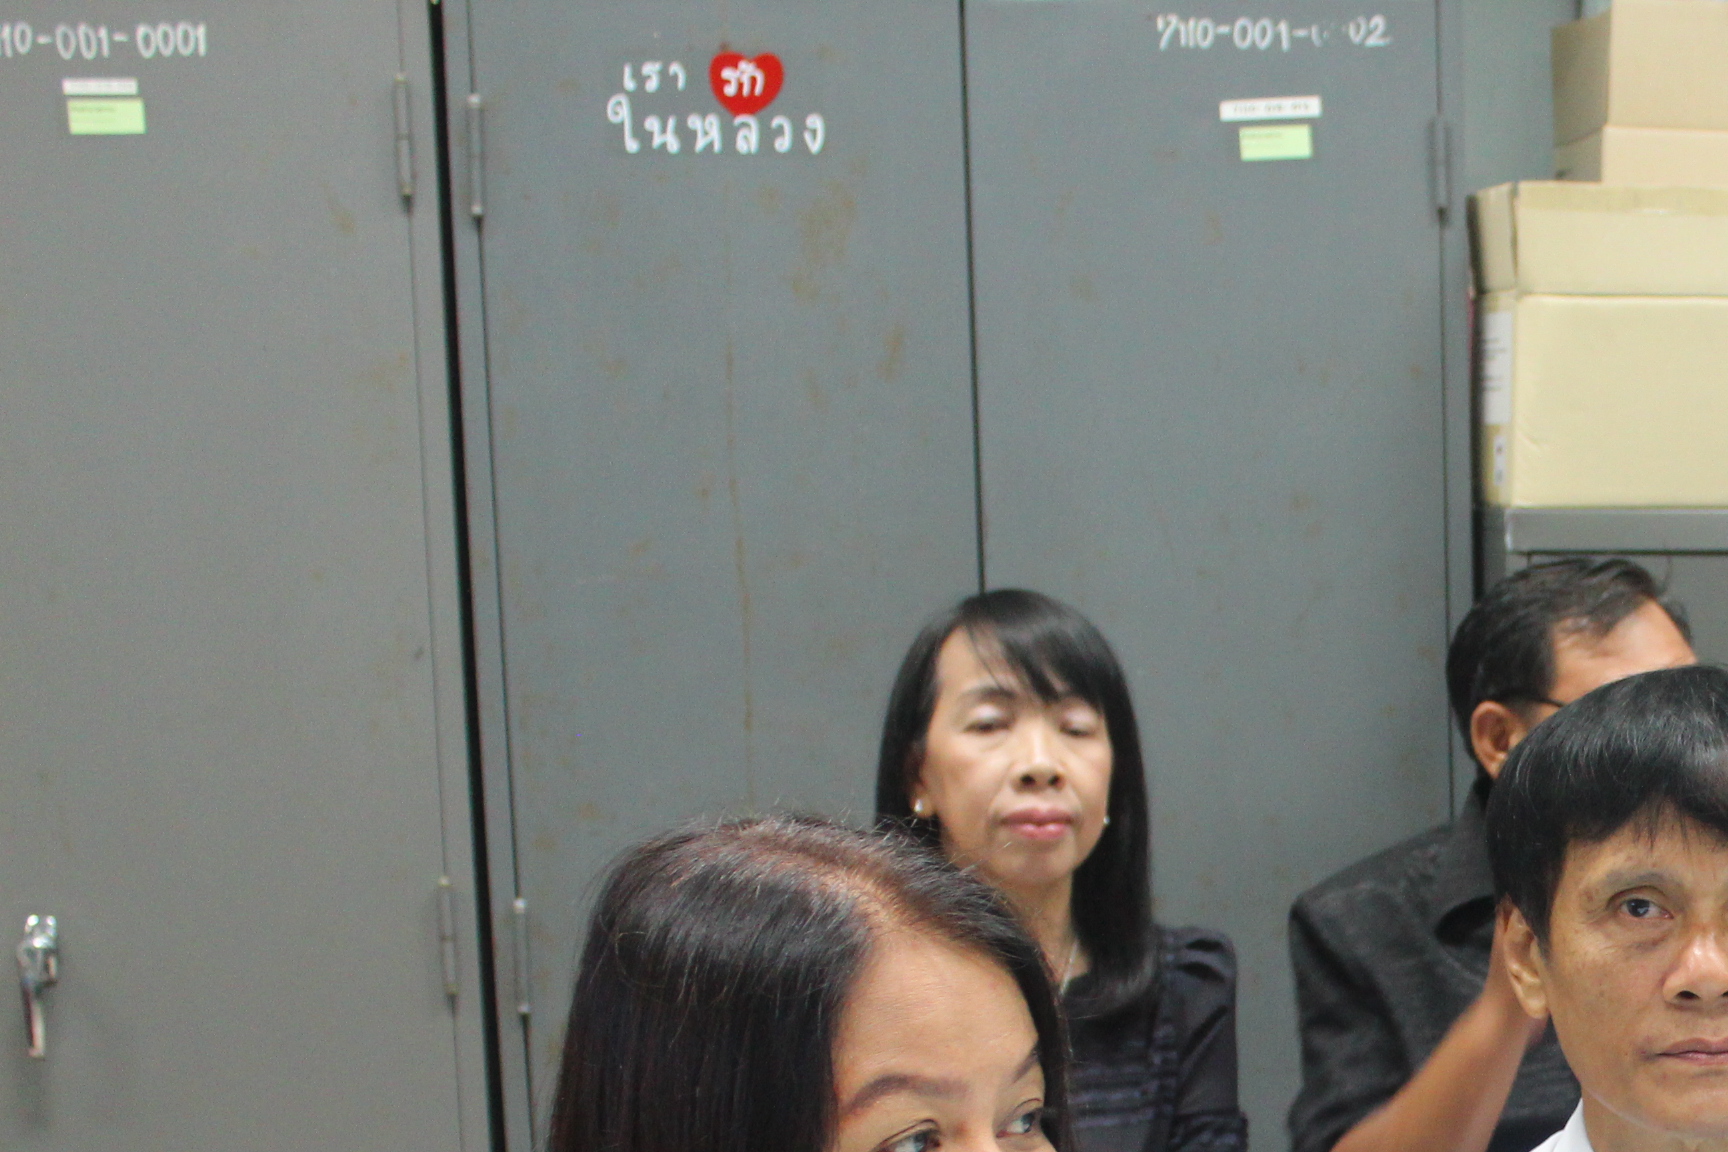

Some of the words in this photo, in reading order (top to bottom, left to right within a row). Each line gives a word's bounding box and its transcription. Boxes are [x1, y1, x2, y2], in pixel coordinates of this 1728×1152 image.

[0, 21, 208, 60] 10-001-0001
[1157, 14, 1391, 51] 7110-001-02
[622, 61, 687, 93] เรา
[720, 60, 765, 97] รัก
[607, 93, 825, 154] ในหลวง
